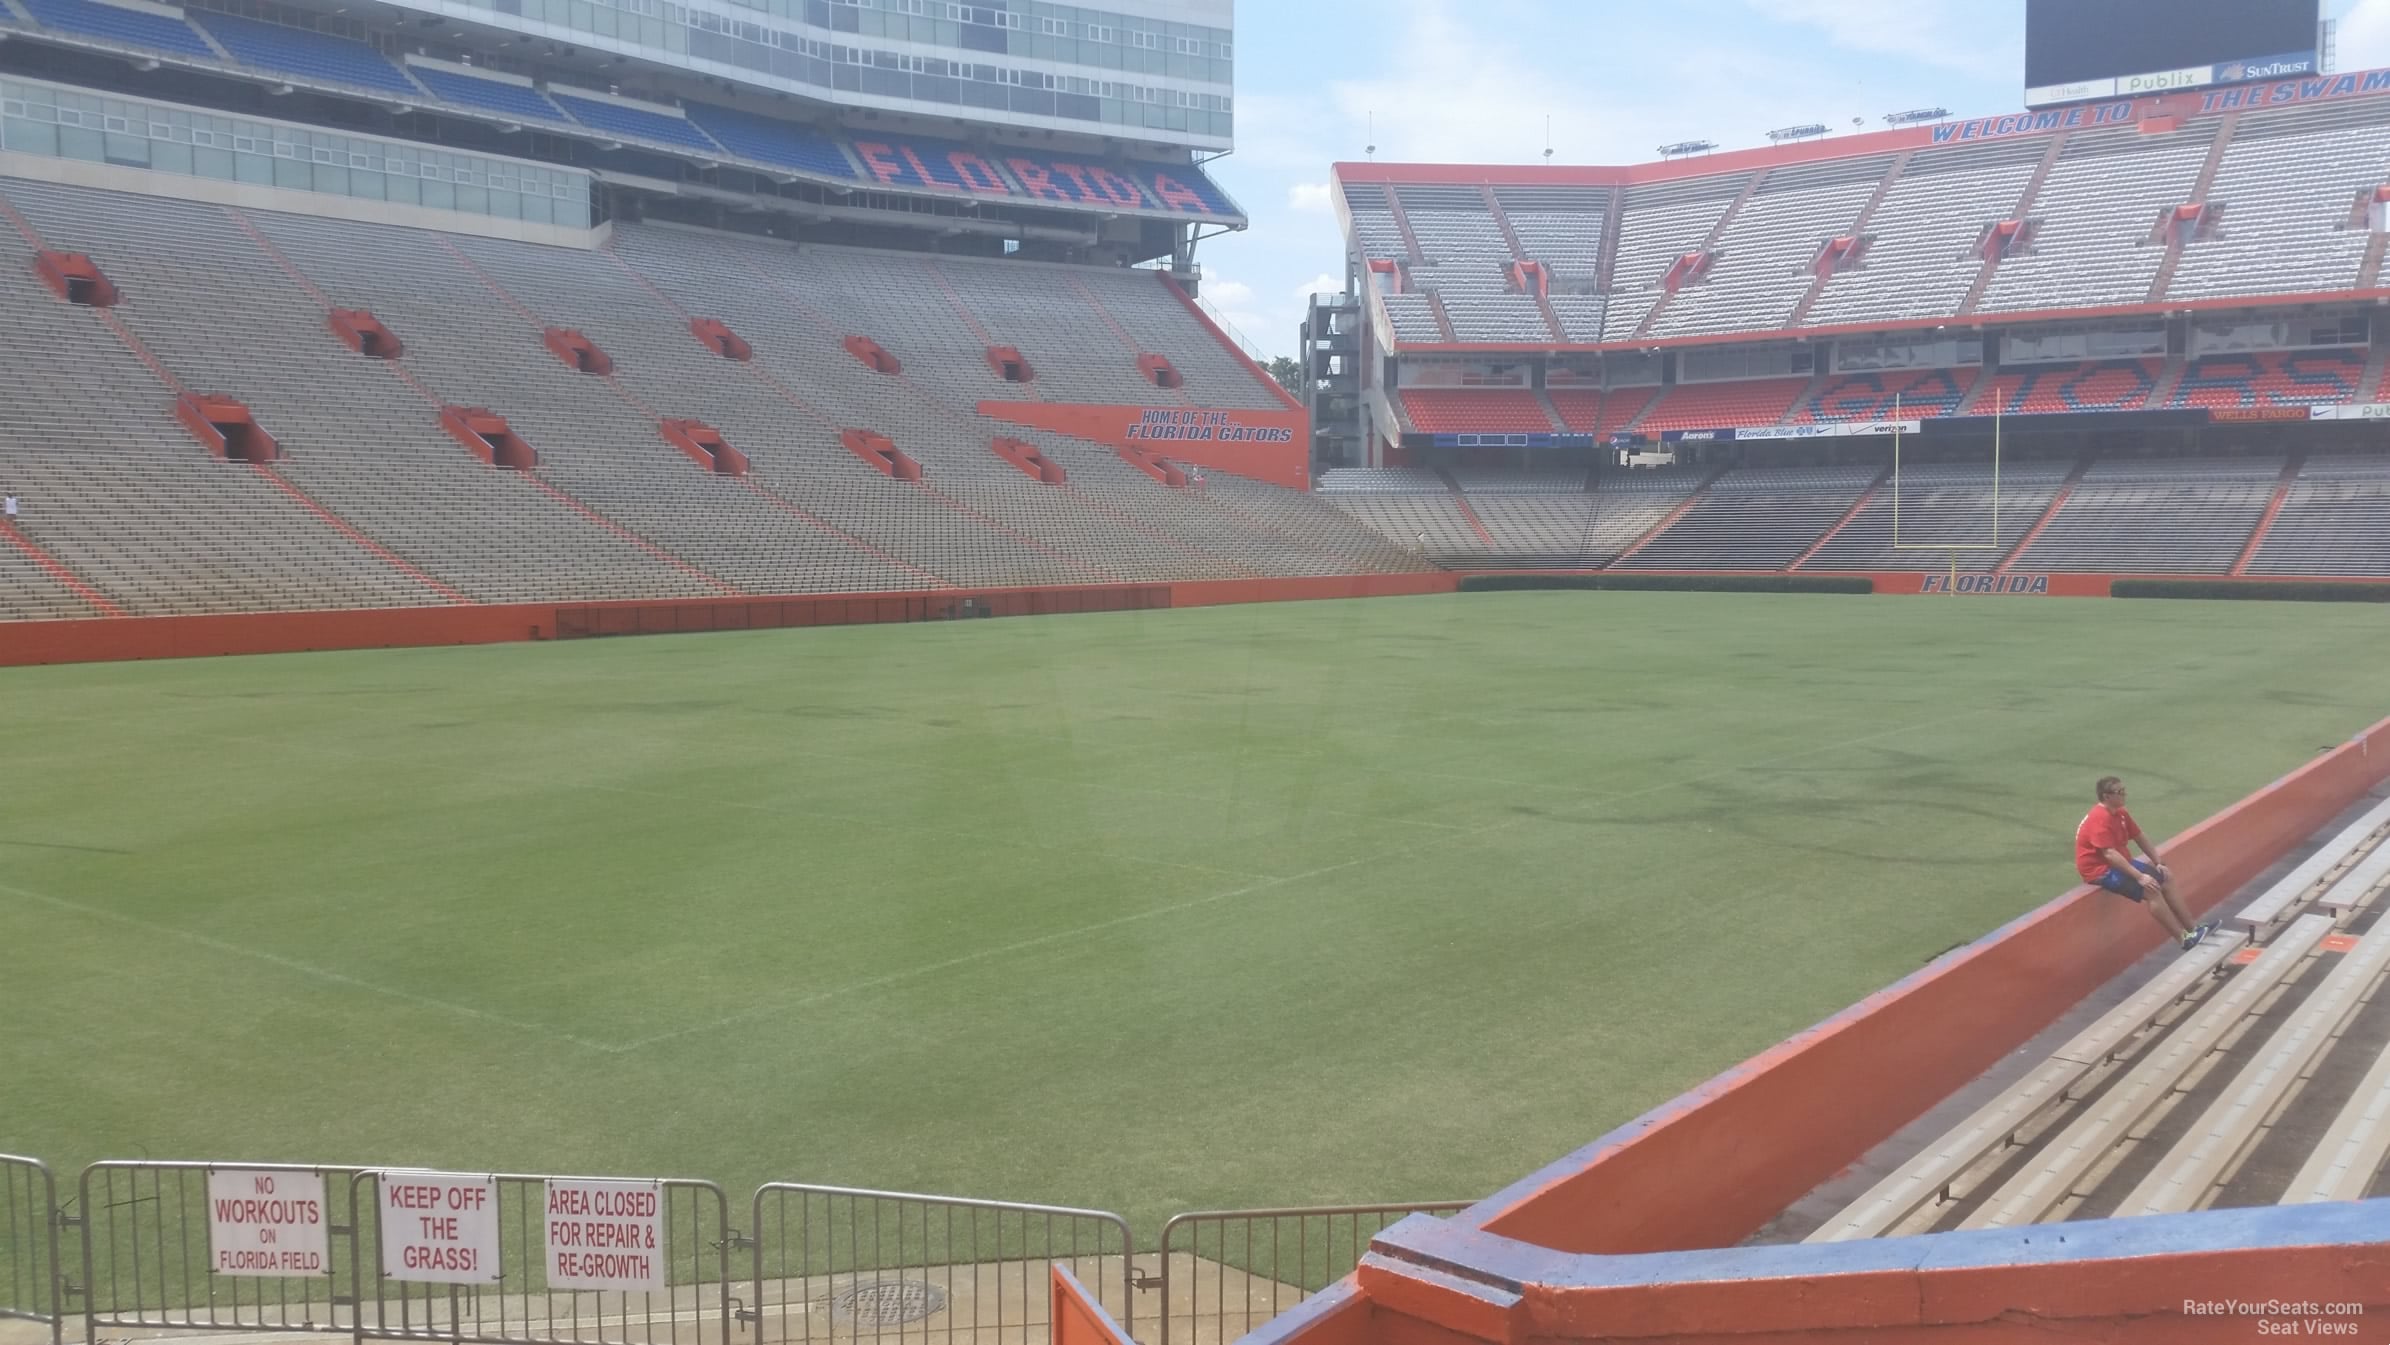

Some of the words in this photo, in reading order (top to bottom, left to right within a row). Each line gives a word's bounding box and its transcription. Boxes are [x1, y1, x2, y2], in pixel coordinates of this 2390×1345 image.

[2129, 72, 2194, 91] Publix
[1931, 107, 2086, 145] WELCOME
[2093, 101, 2132, 124] TO
[2200, 84, 2267, 113] THE
[855, 142, 1212, 214] FLORIDA
[1142, 410, 1179, 425] HOME
[1182, 411, 1198, 426] OF
[2214, 410, 2258, 420] WELLS
[2262, 408, 2305, 418] FARGO
[1126, 423, 1212, 441] FLORIDA
[1218, 427, 1293, 443] GATORS
[1681, 431, 1715, 440] Aaron's
[1737, 429, 1771, 438] Florida
[1775, 428, 1794, 437] Blue
[1920, 574, 2048, 593] FLORIDA
[254, 1176, 275, 1195] NO
[390, 1185, 441, 1209] KEEP
[447, 1187, 486, 1211] OFF
[549, 1189, 590, 1215] AREA
[595, 1191, 656, 1217] CLOSED
[215, 1199, 319, 1225] WORKOUTS
[259, 1228, 276, 1244] ON
[420, 1216, 458, 1240] THE
[551, 1221, 581, 1246] FOR
[586, 1222, 640, 1249] REPAIR
[645, 1224, 655, 1249] &
[220, 1250, 278, 1270] FLORIDA
[281, 1252, 320, 1271] FIELD
[403, 1245, 477, 1271] GRASS!
[558, 1252, 650, 1280] RE-GROWTH
